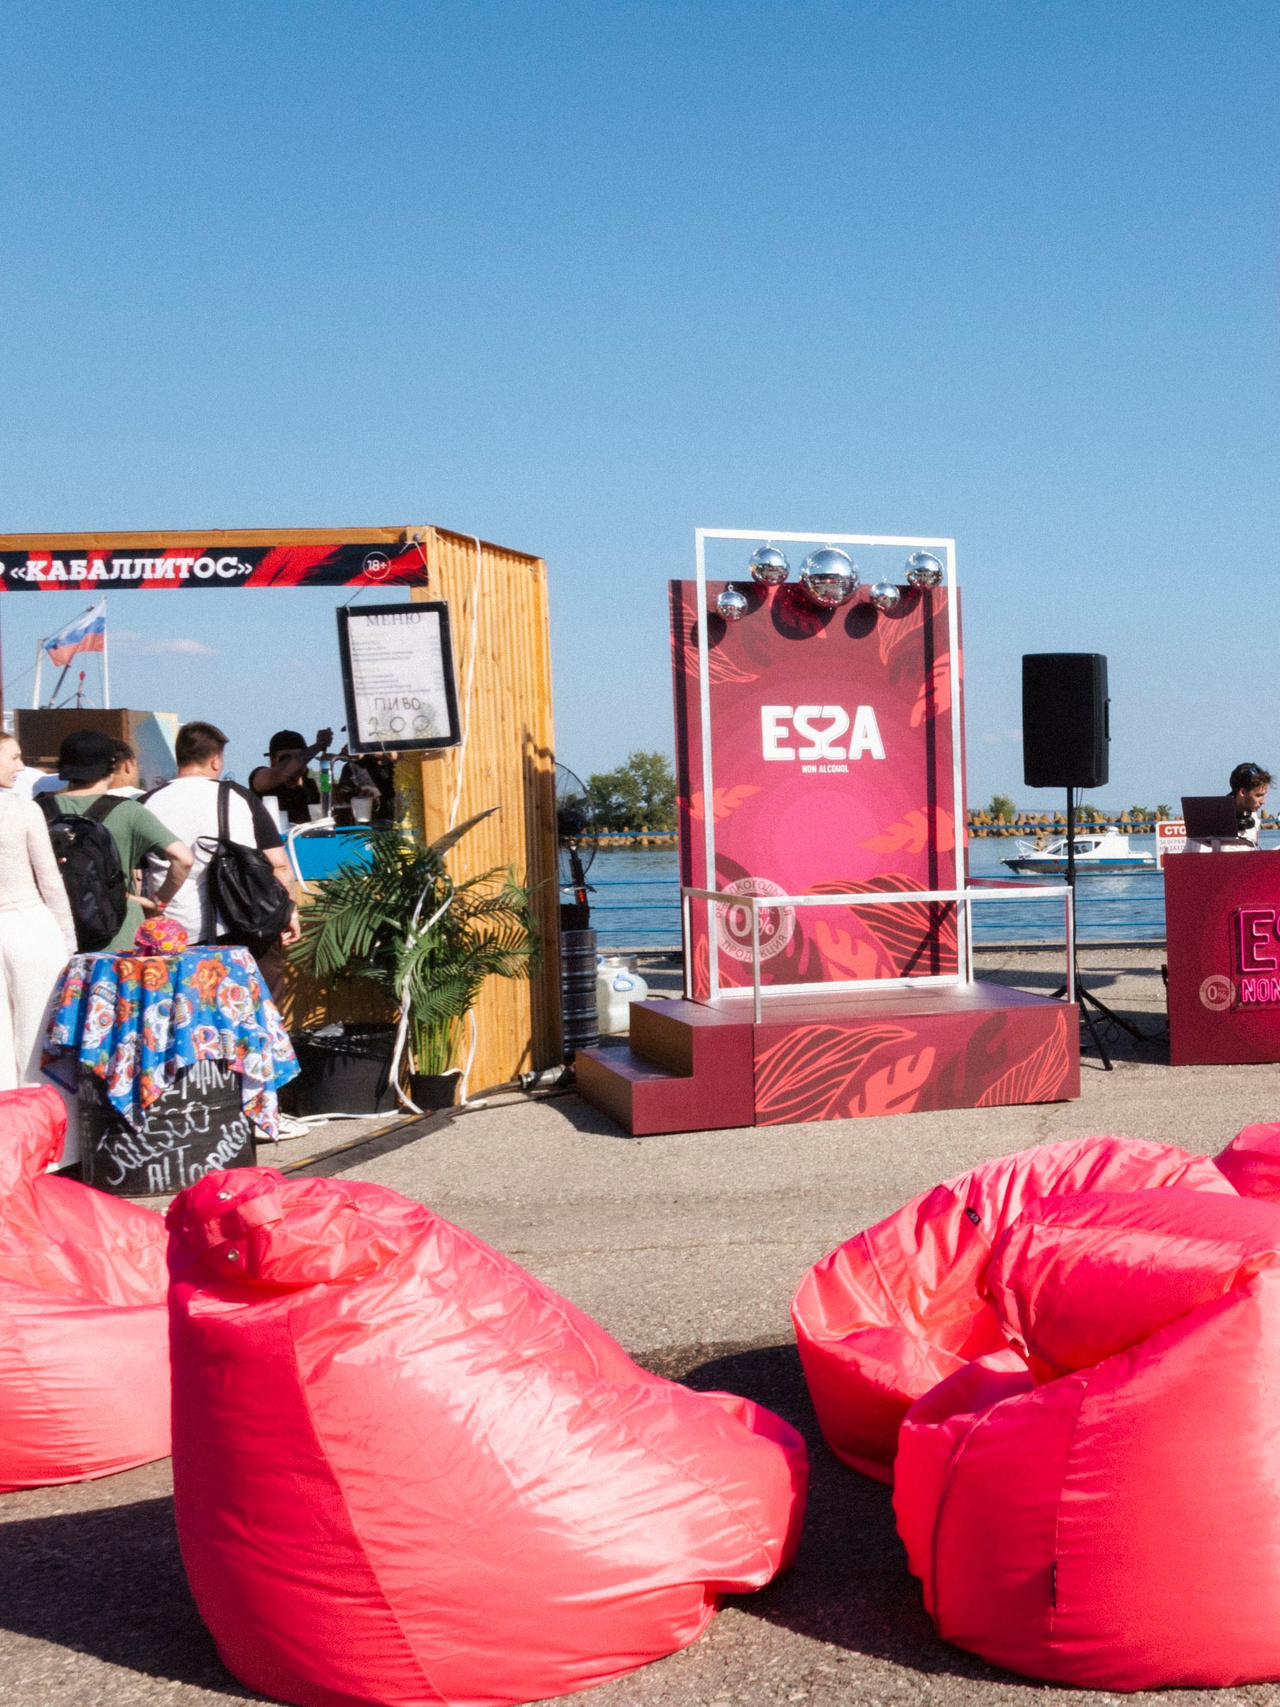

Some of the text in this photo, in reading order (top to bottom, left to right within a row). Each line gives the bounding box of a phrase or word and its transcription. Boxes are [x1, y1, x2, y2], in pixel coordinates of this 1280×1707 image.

[366, 560, 388, 572] 18+
[374, 697, 422, 711] ПИВО
[802, 765, 849, 773] NON ALCOHOL
[1164, 825, 1187, 836] СТО
[722, 934, 787, 961] ПРОДКЦИЯ
